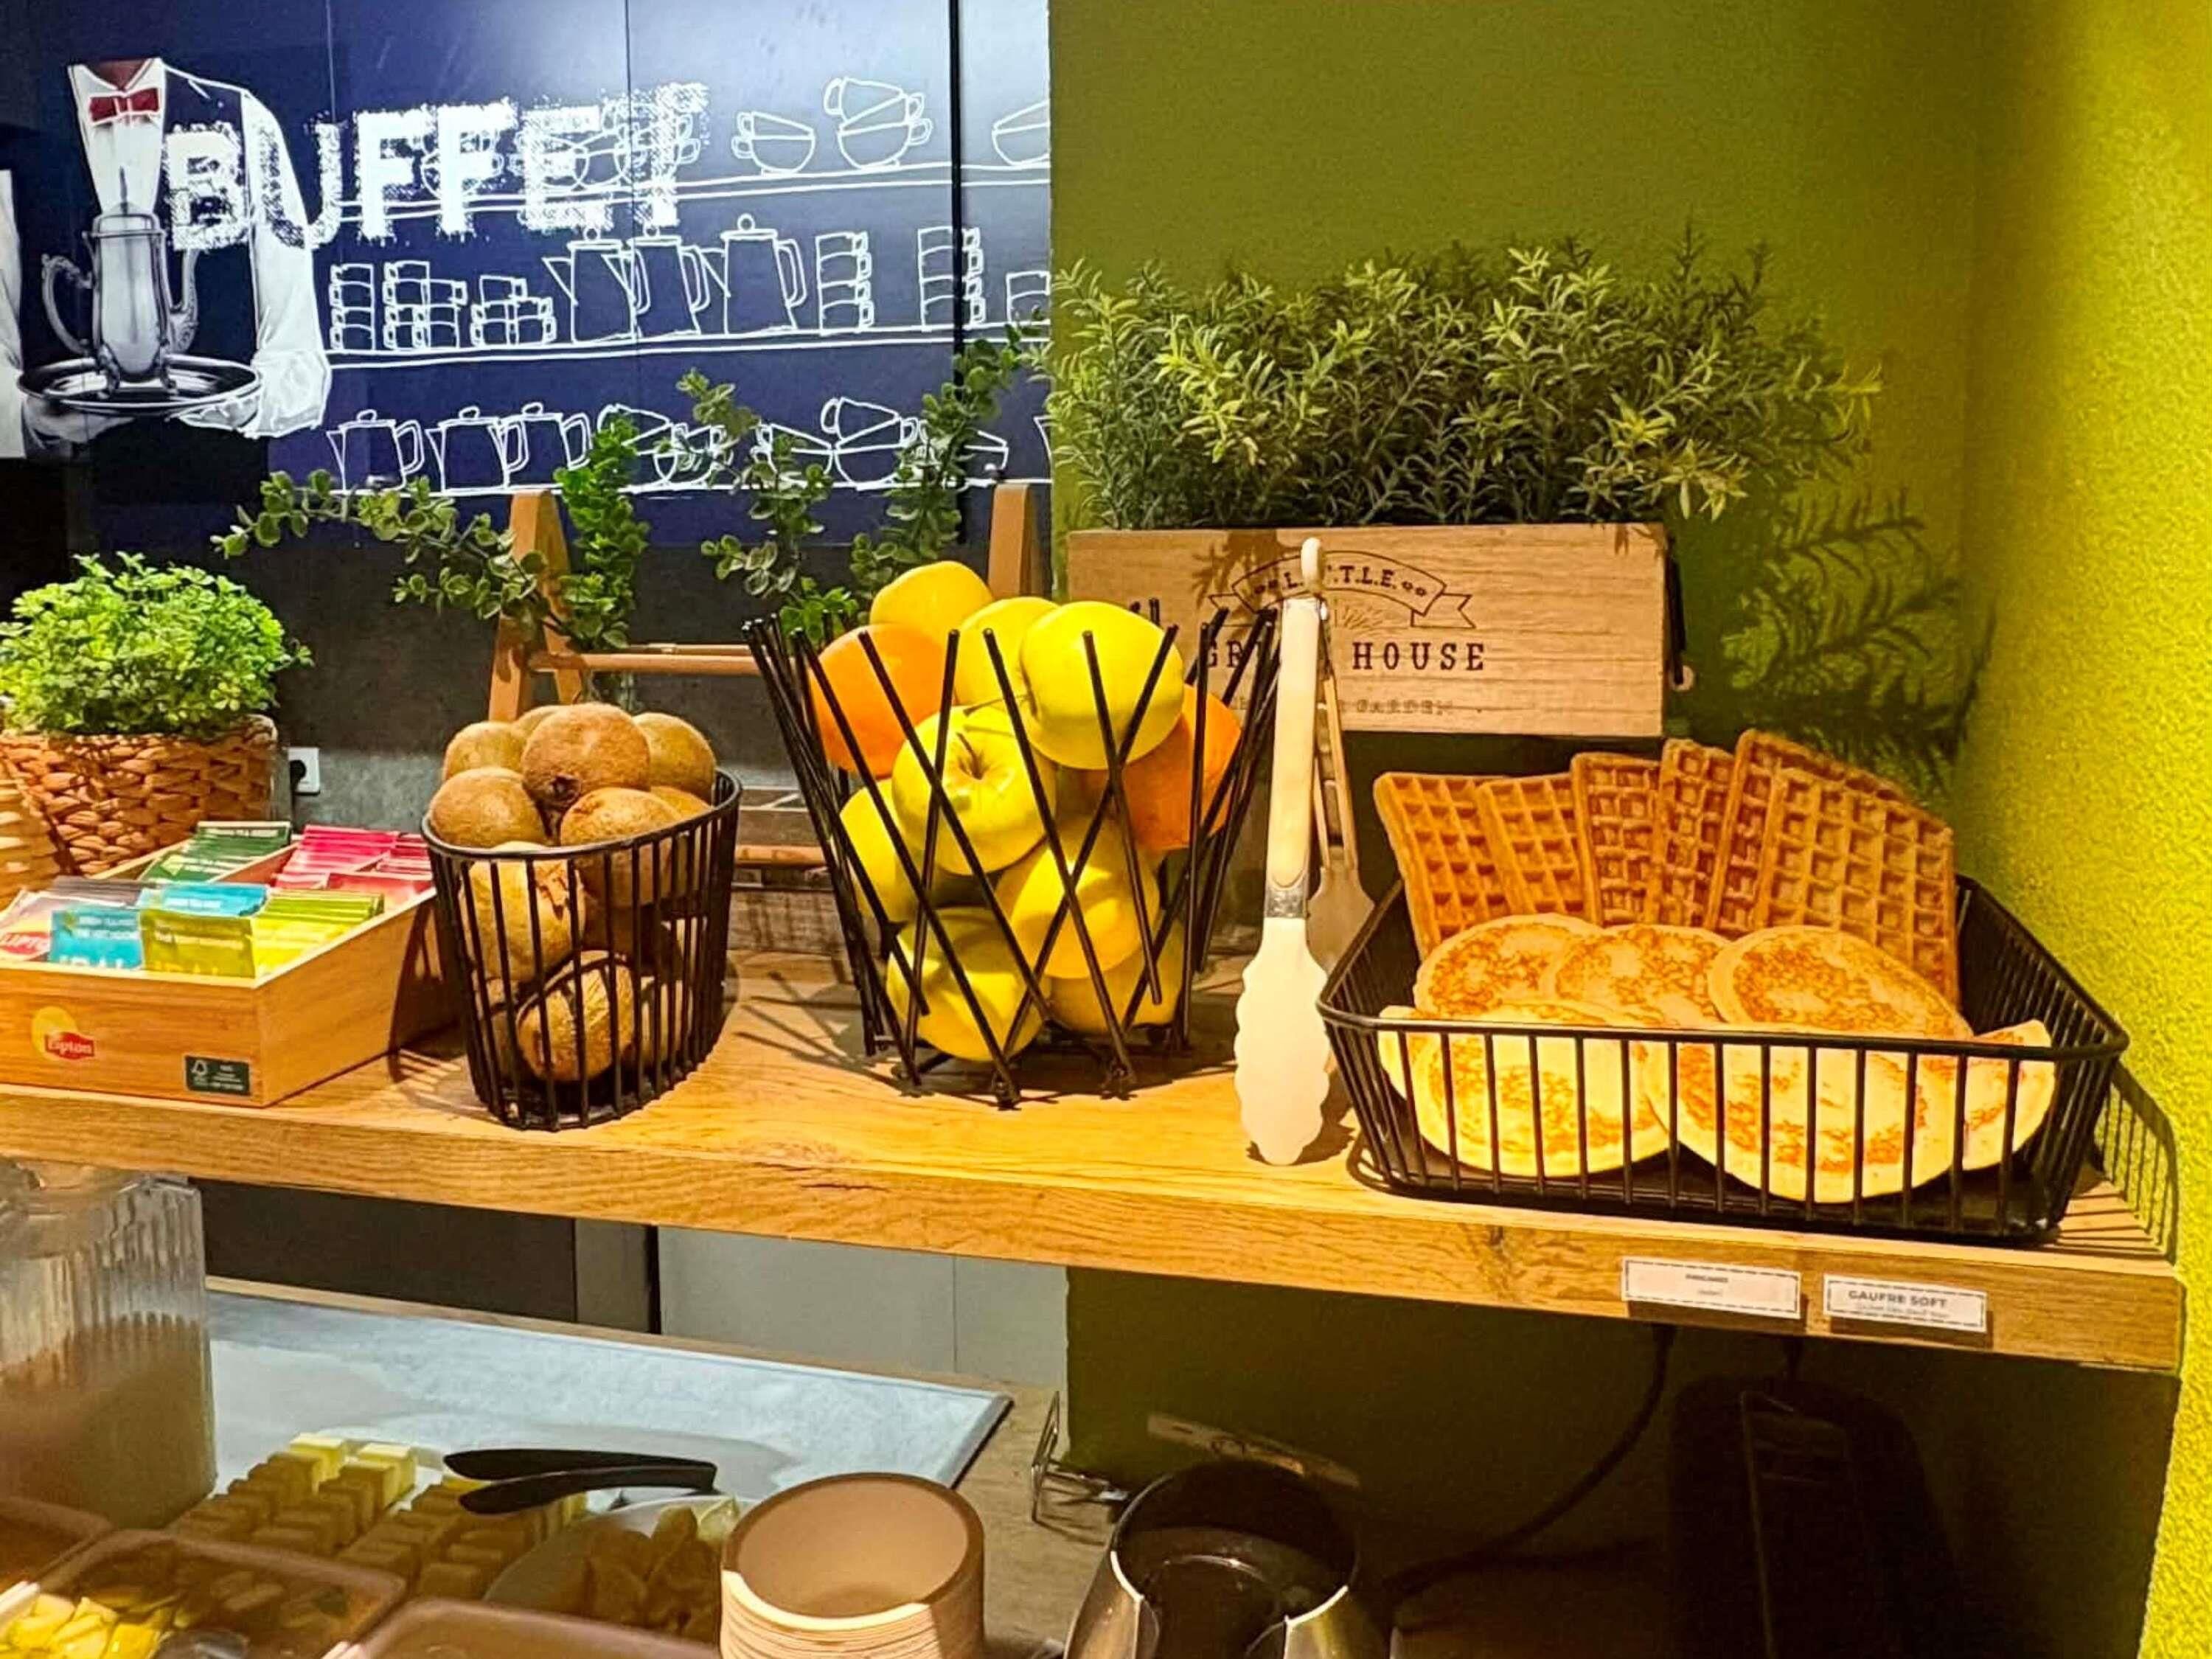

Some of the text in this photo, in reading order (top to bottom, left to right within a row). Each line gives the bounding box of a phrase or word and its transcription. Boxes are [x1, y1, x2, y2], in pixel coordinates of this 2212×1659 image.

[164, 84, 709, 249] BUFFET
[1352, 642, 1484, 670] HOUSE
[47, 1037, 92, 1055] Lipton
[1848, 1290, 1947, 1307] GAUFRE SOFT
